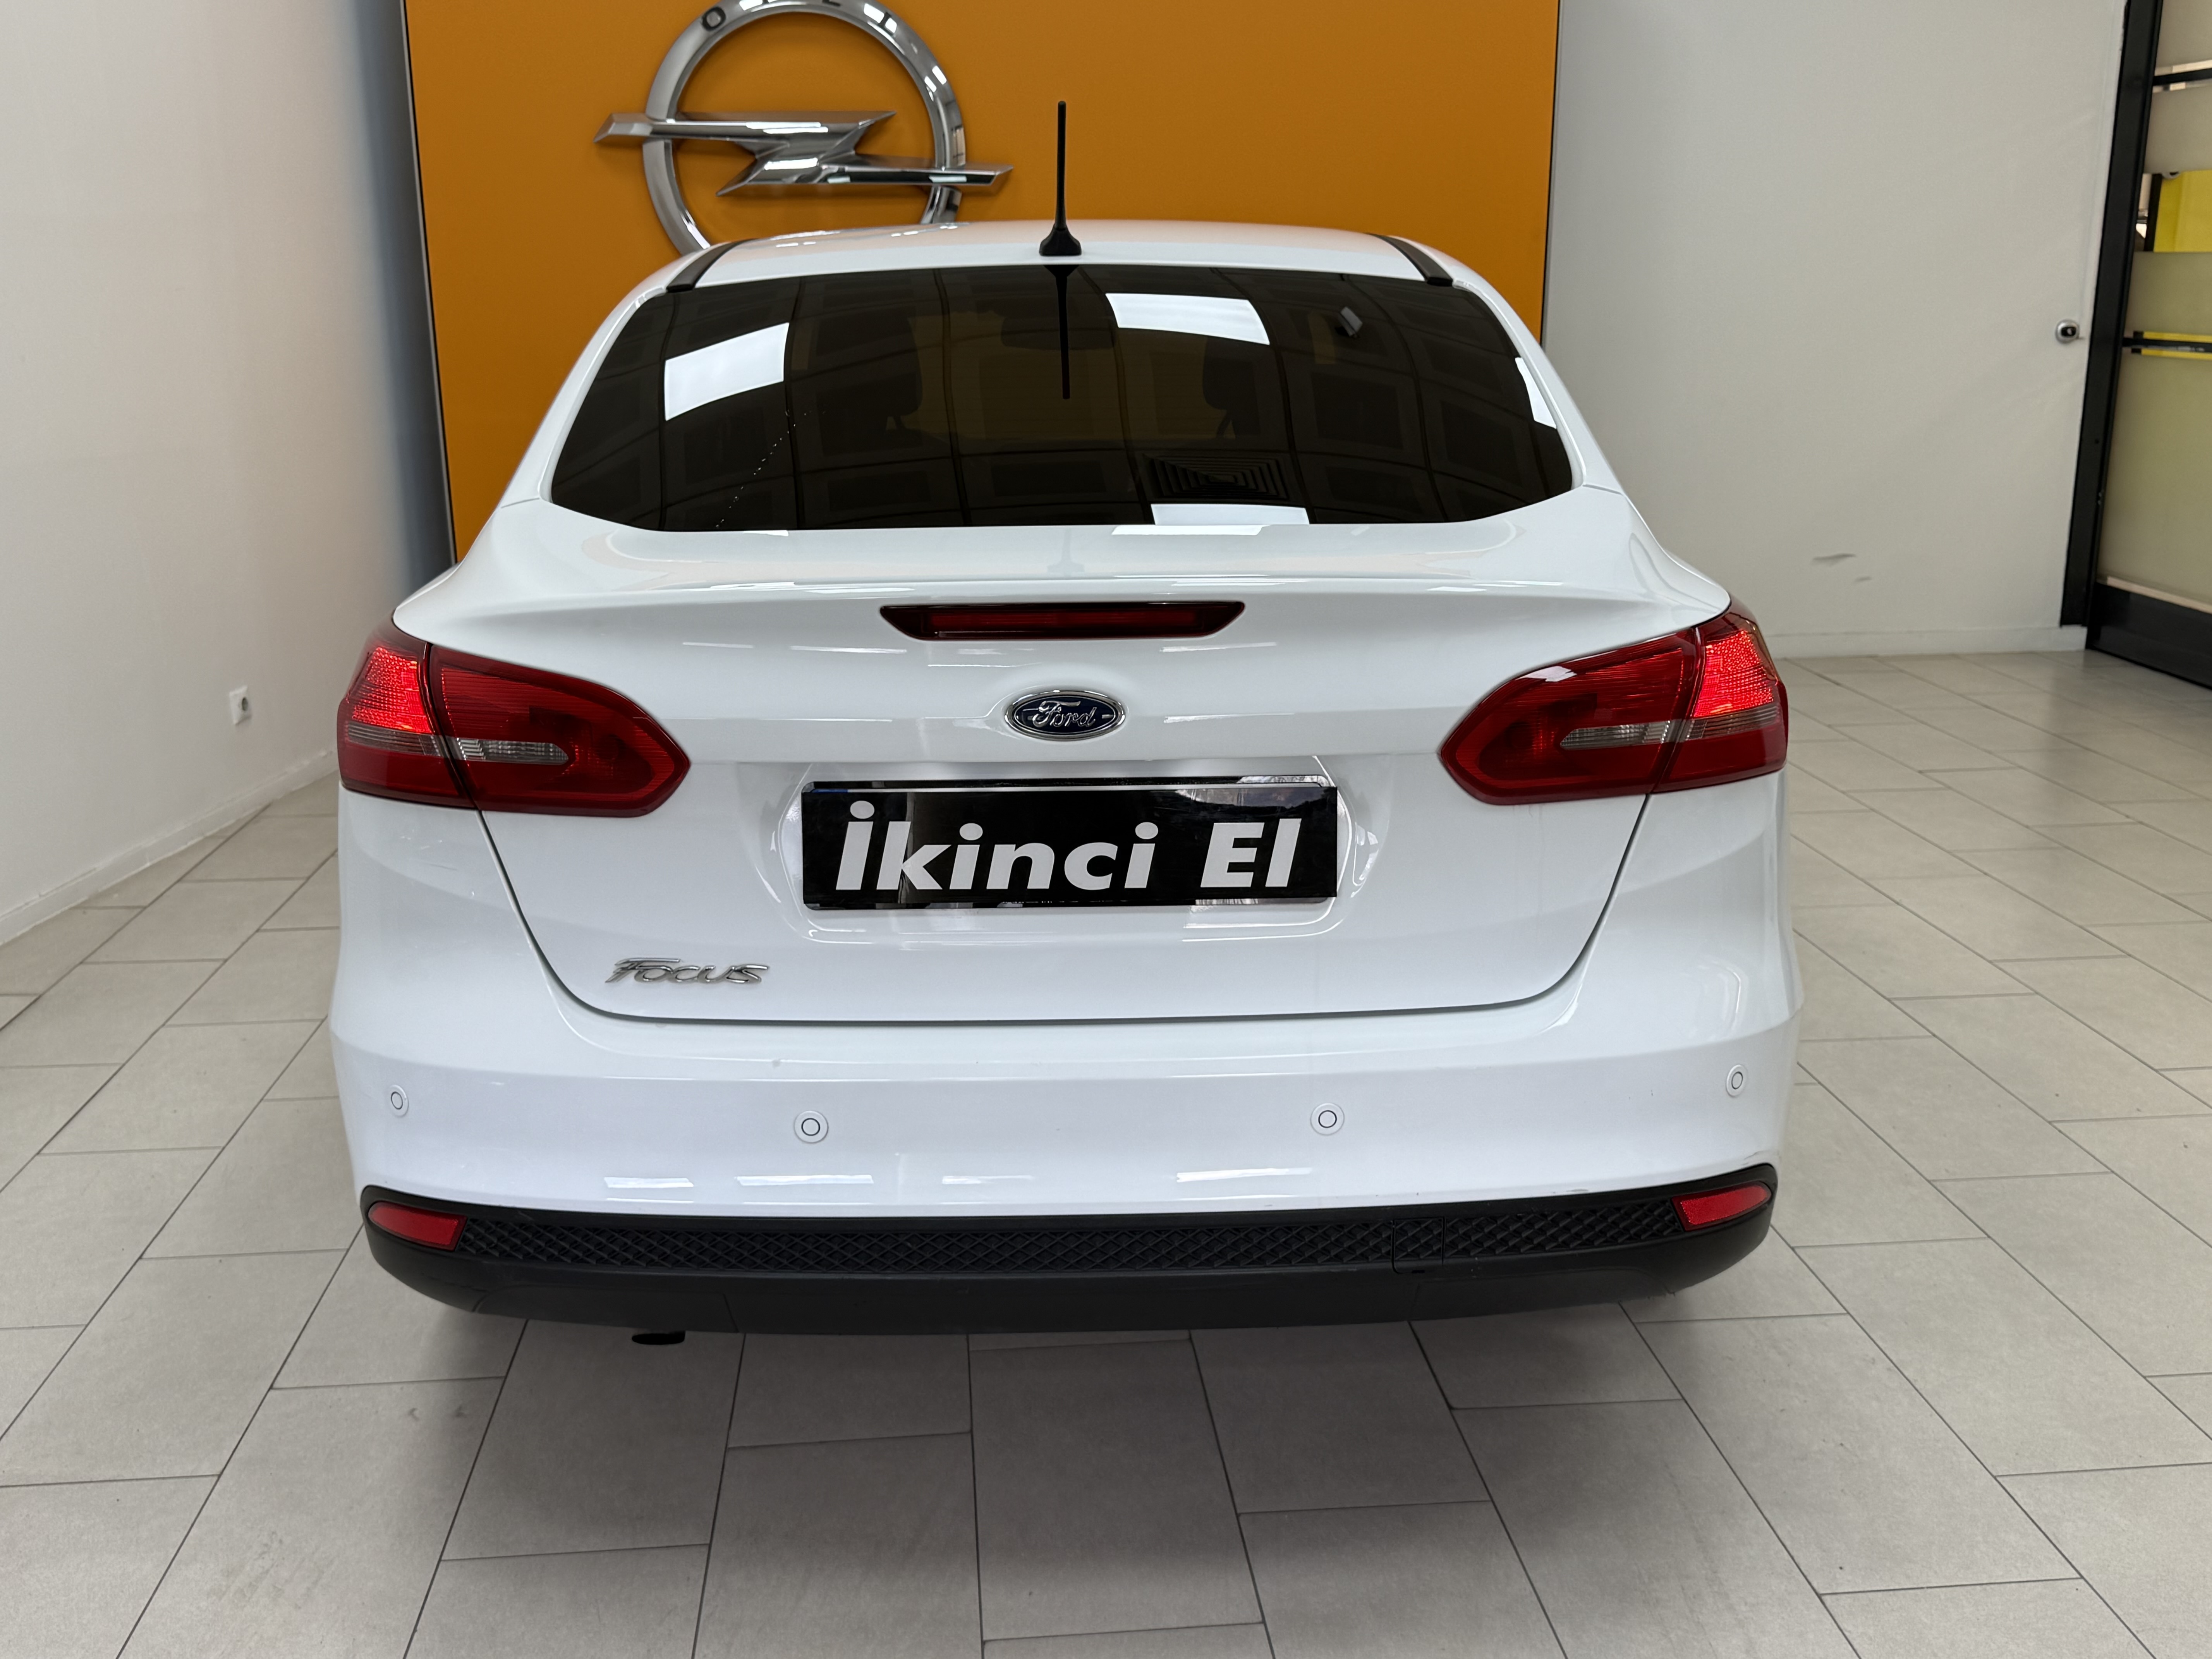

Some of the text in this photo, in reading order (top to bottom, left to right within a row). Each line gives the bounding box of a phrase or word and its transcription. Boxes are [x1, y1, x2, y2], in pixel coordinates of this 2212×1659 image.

[1023, 701, 1097, 727] Ford
[836, 800, 1302, 890] İkinci El
